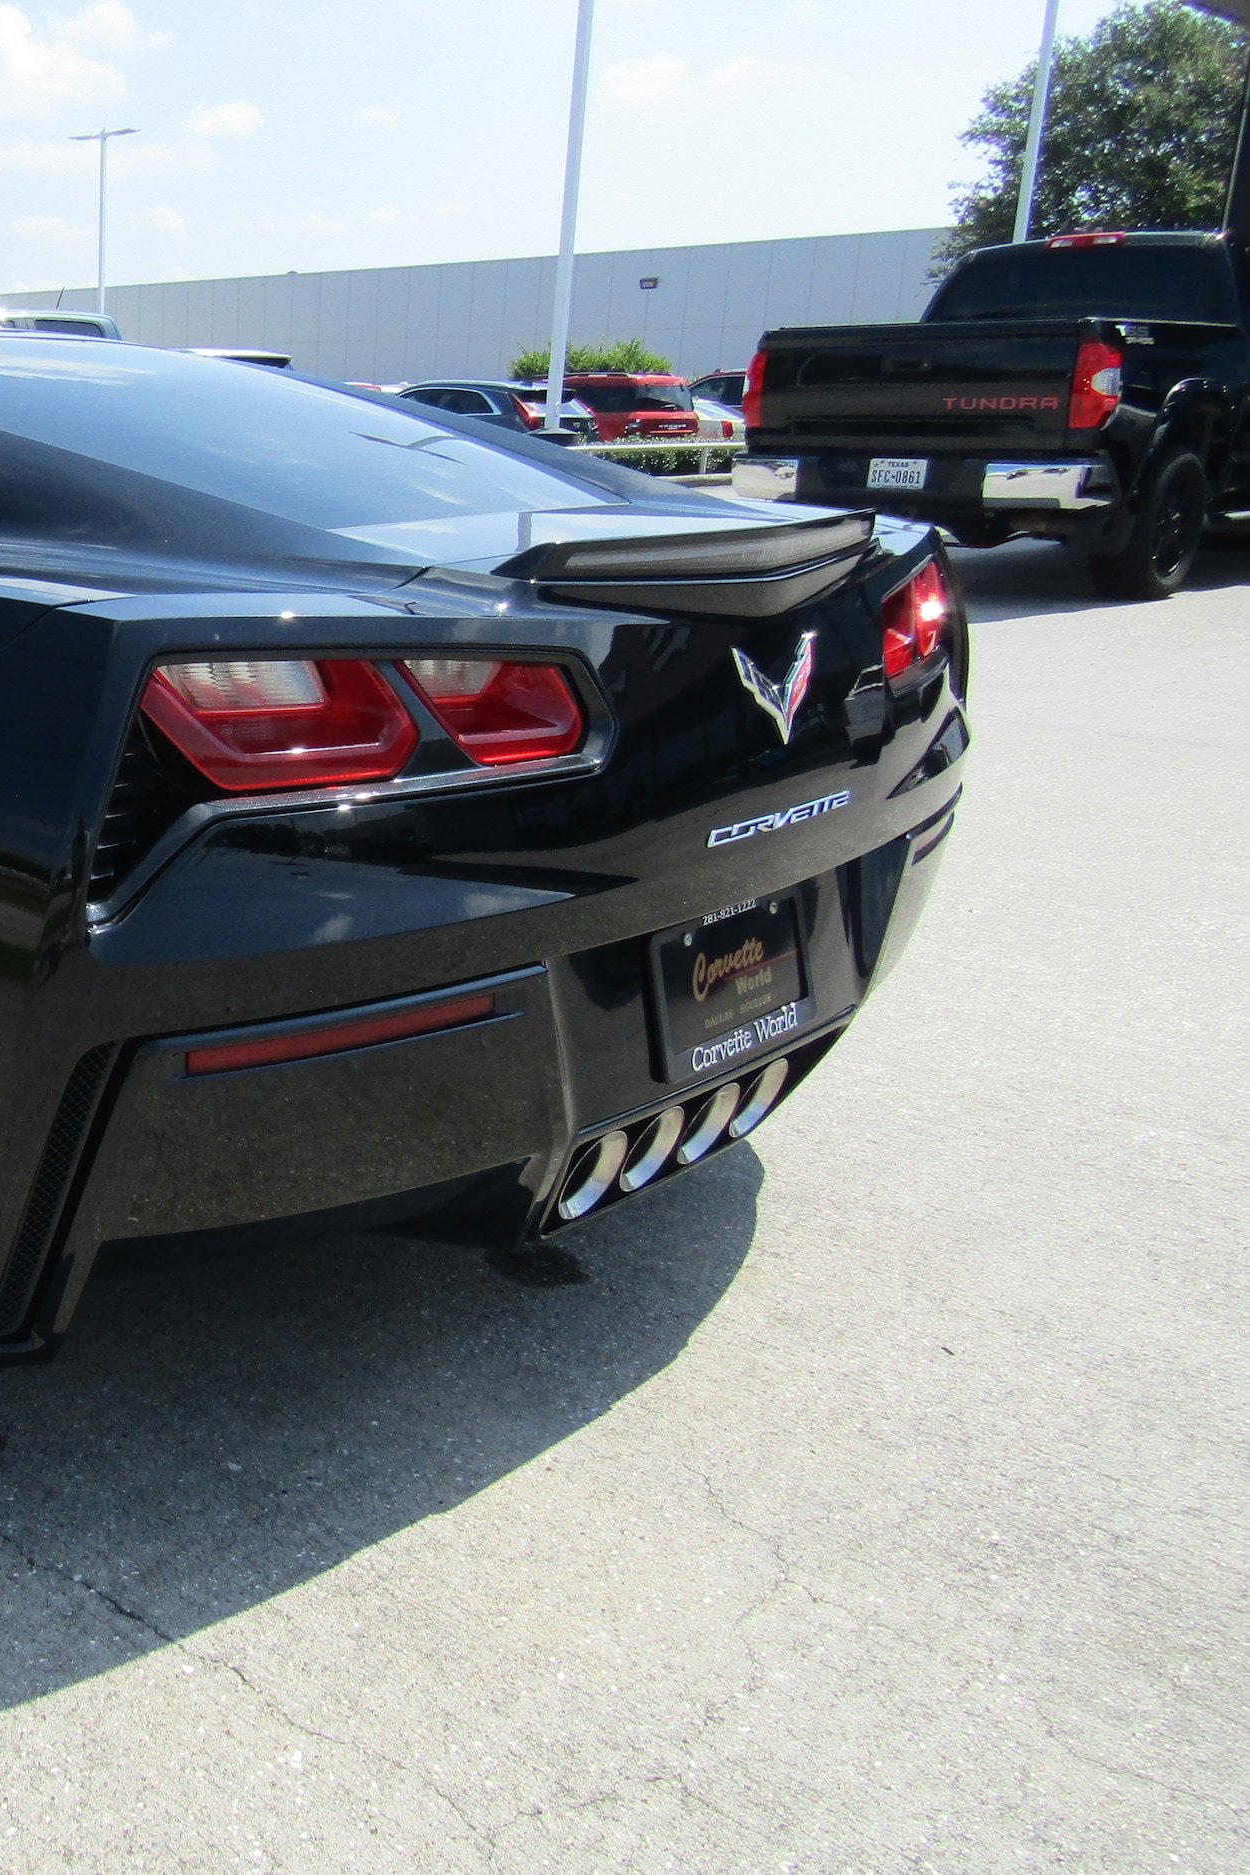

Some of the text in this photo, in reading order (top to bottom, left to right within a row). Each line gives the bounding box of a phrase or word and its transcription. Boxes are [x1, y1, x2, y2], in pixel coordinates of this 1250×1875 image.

[942, 397, 1059, 410] TUNDRA
[707, 790, 850, 848] CORVETTE
[702, 899, 757, 926] 281-821-1222
[692, 936, 765, 1002] Corvette
[735, 965, 772, 995] World
[705, 1008, 734, 1029] DALLAS
[692, 1001, 798, 1072] Corvette World
